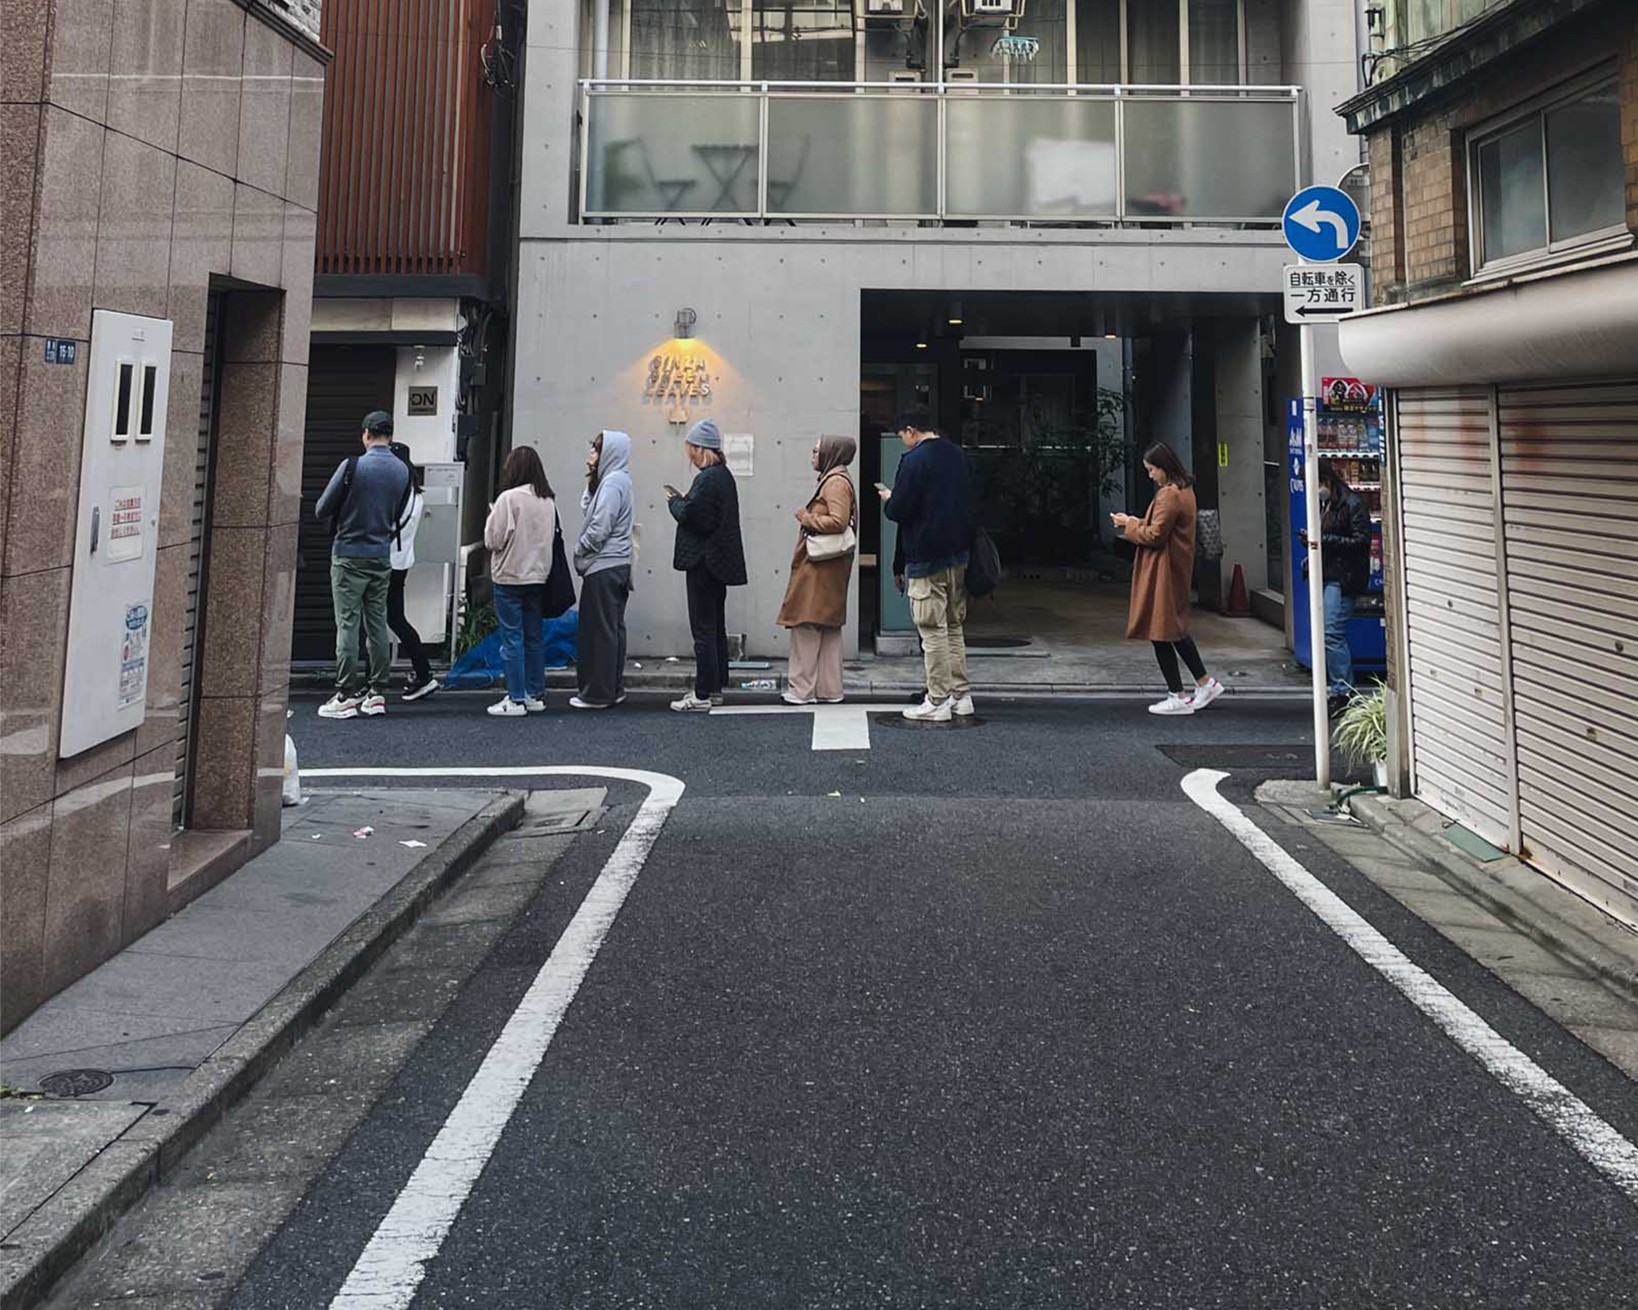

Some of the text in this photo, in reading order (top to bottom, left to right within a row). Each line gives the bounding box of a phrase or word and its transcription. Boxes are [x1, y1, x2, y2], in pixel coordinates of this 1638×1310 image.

[1290, 271, 1355, 286] 自転車を除く
[1290, 288, 1356, 303] 一方通行
[644, 383, 711, 397] LEAVES
